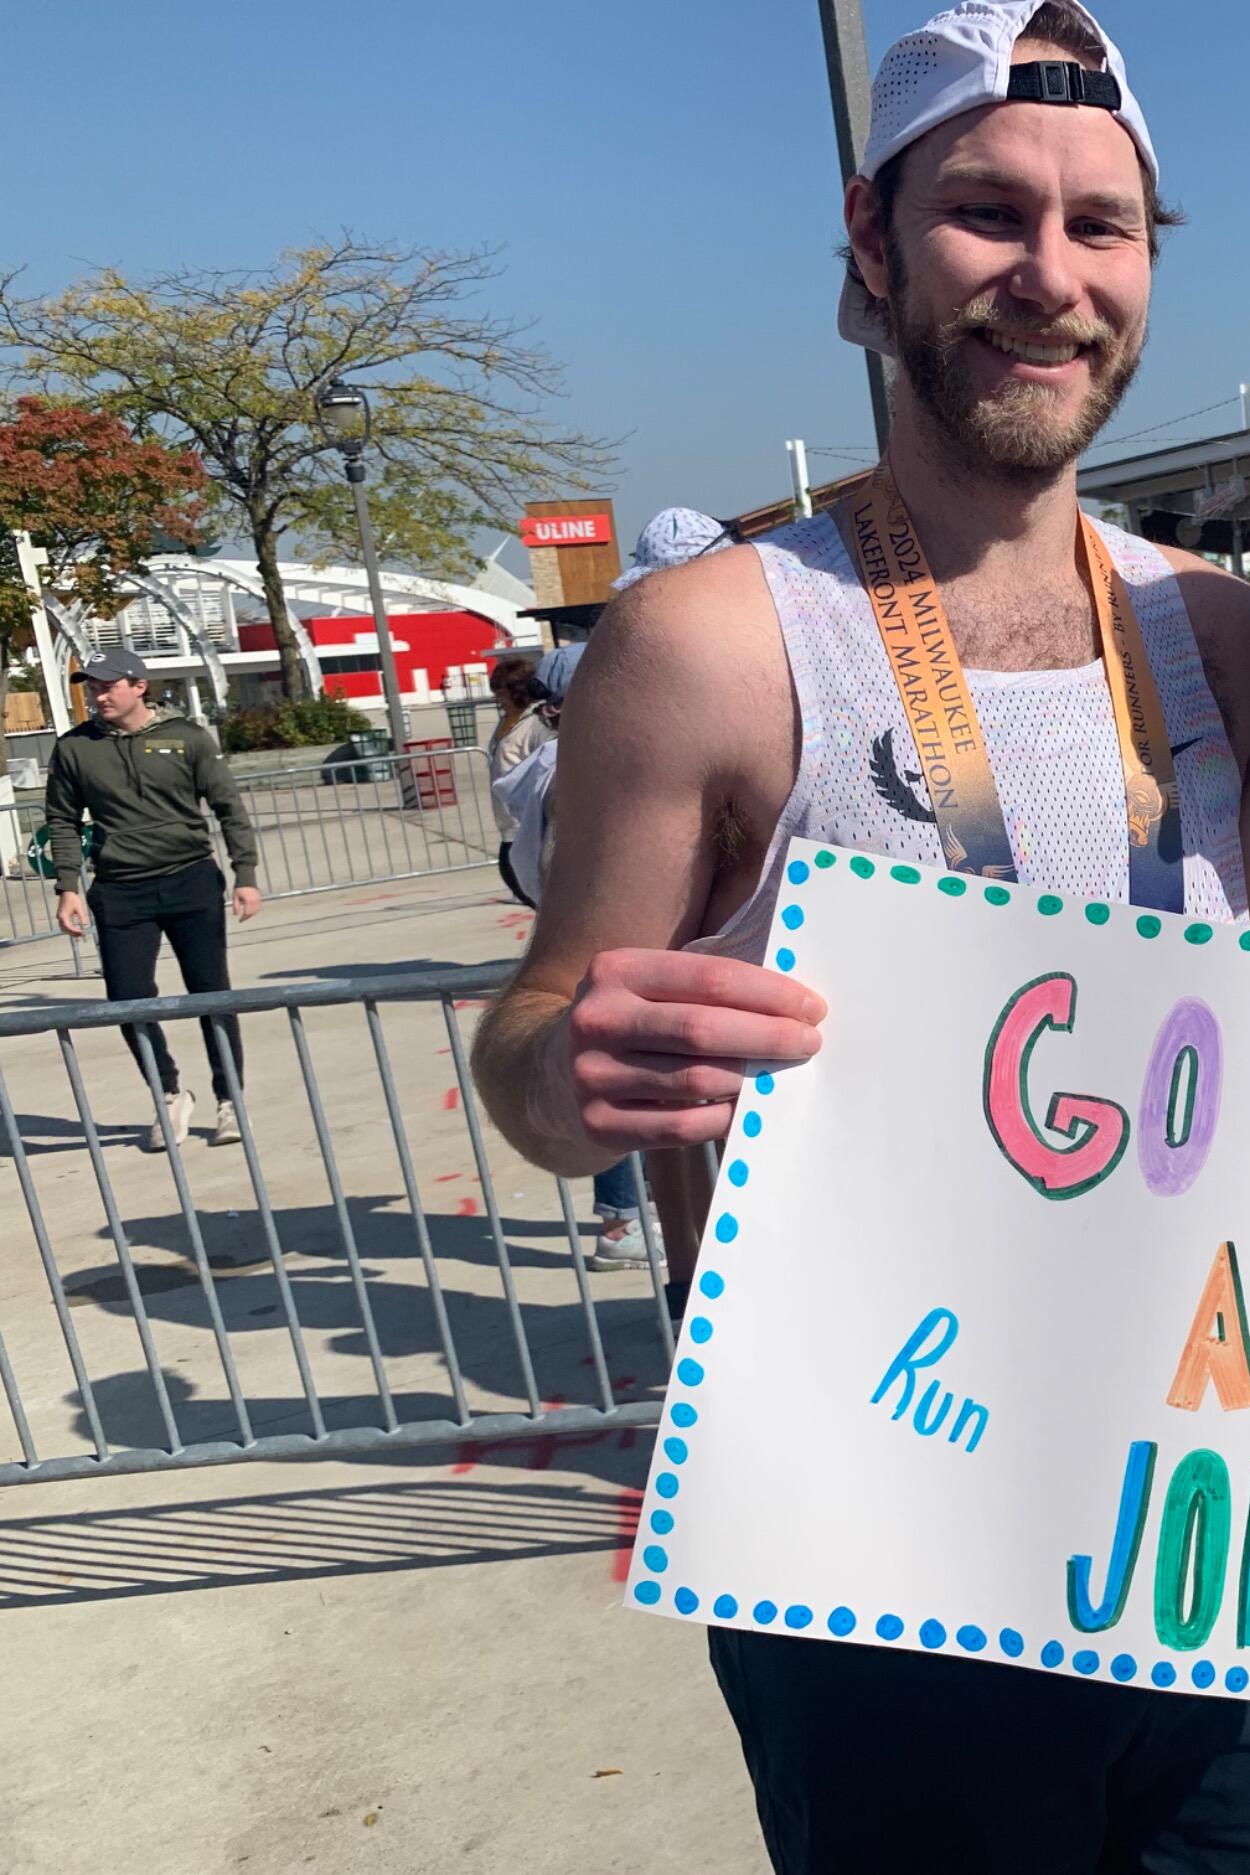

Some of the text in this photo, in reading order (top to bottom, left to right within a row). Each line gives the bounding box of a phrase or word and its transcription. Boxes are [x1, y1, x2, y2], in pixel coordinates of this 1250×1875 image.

[535, 520, 596, 540] ULINE
[854, 502, 959, 811] LAKEFRONT MARATHON
[889, 521, 977, 755] 2024 MILWAUKEE
[1112, 616, 1127, 633] BY
[1122, 650, 1147, 735] RUNNERS
[983, 971, 1224, 1201] GO
[870, 1307, 989, 1453] Run
